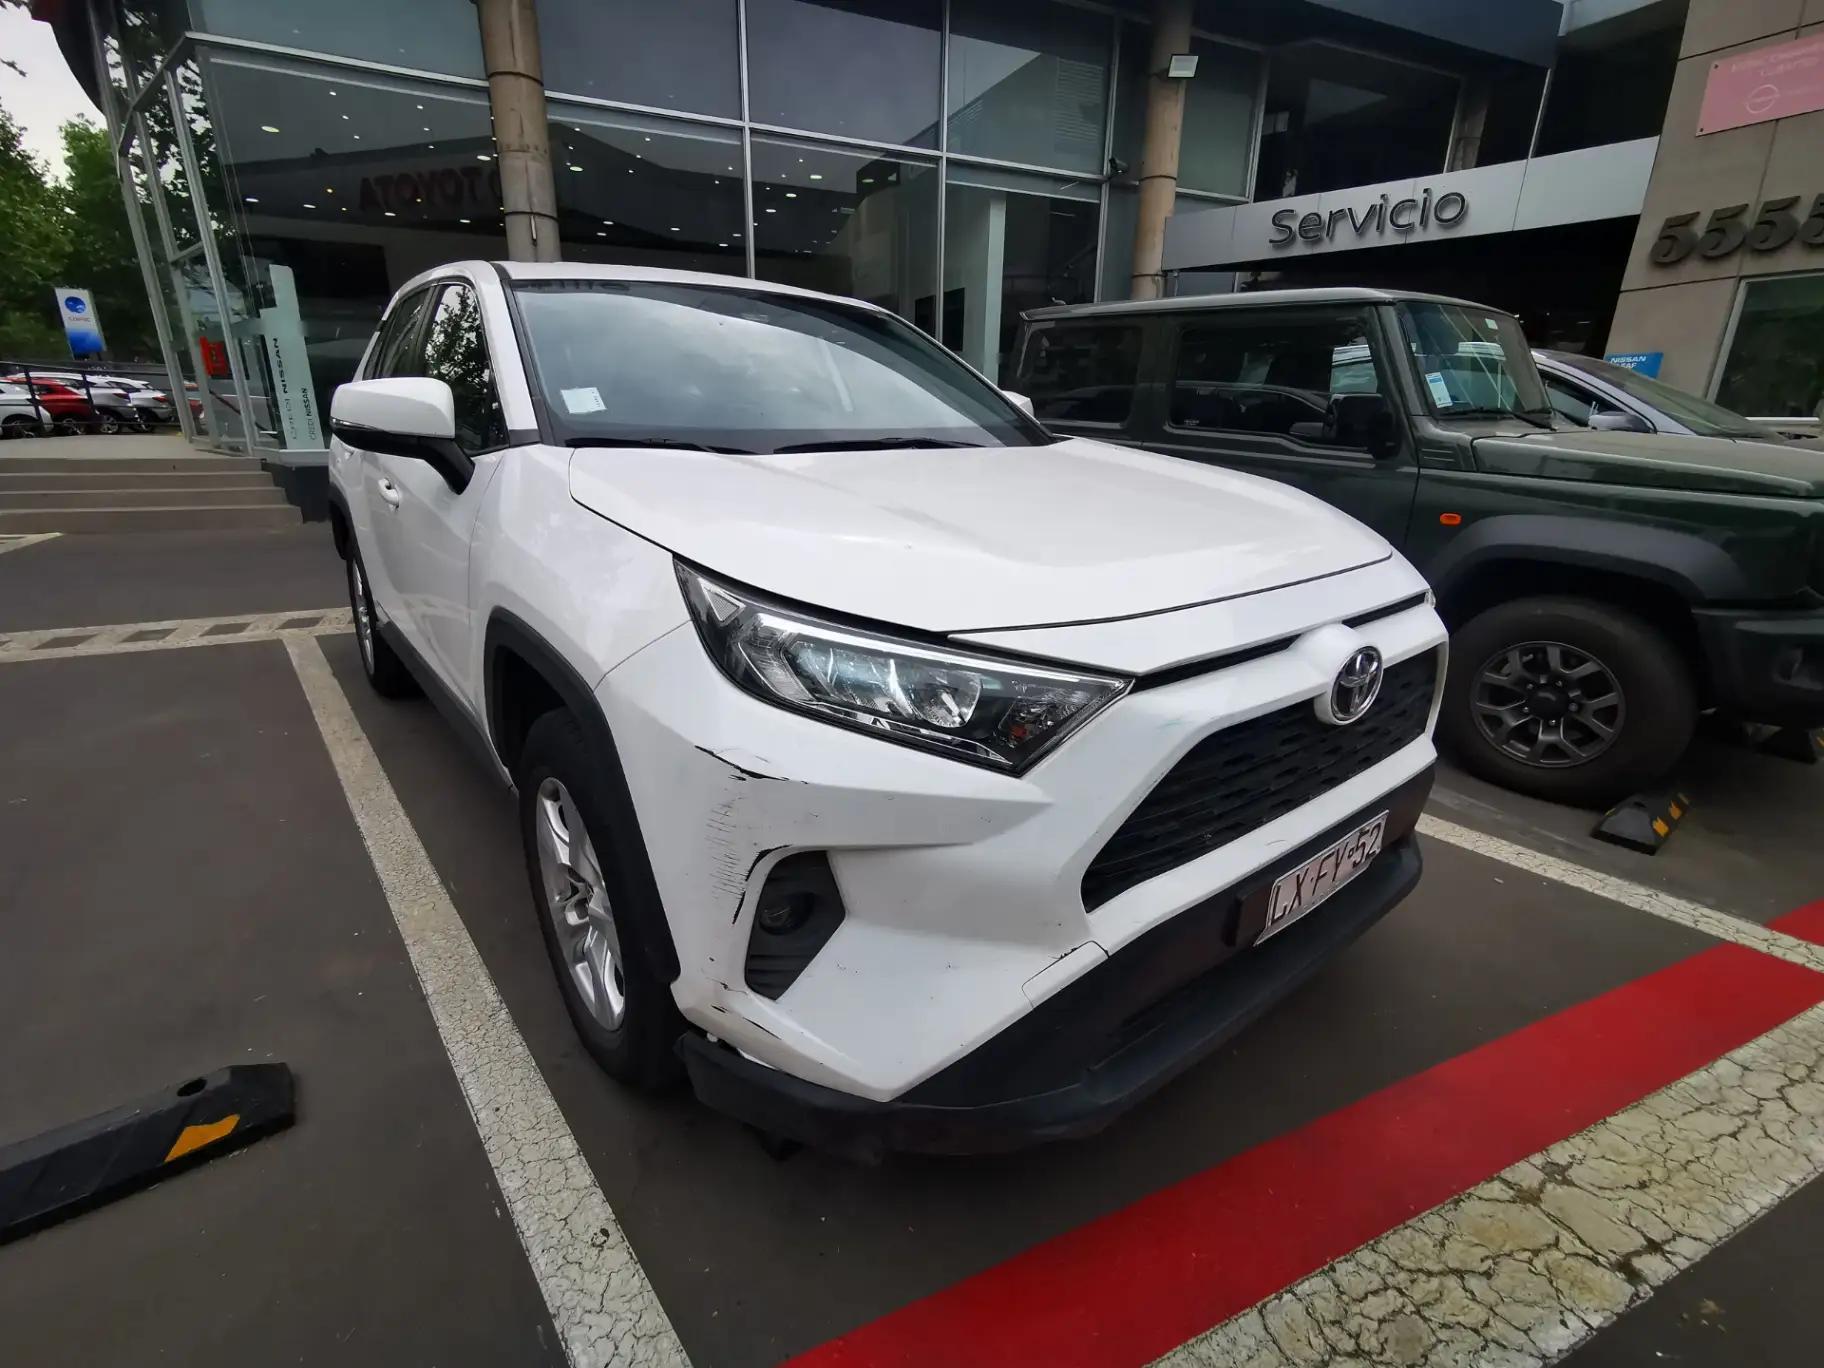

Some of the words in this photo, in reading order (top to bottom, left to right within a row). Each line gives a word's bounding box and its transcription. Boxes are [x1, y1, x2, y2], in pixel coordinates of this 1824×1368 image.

[1268, 186, 1468, 246] Servicio
[273, 337, 288, 393] NISSAN
[1610, 355, 1647, 364] NISSAN
[301, 387, 312, 417] NISSAN
